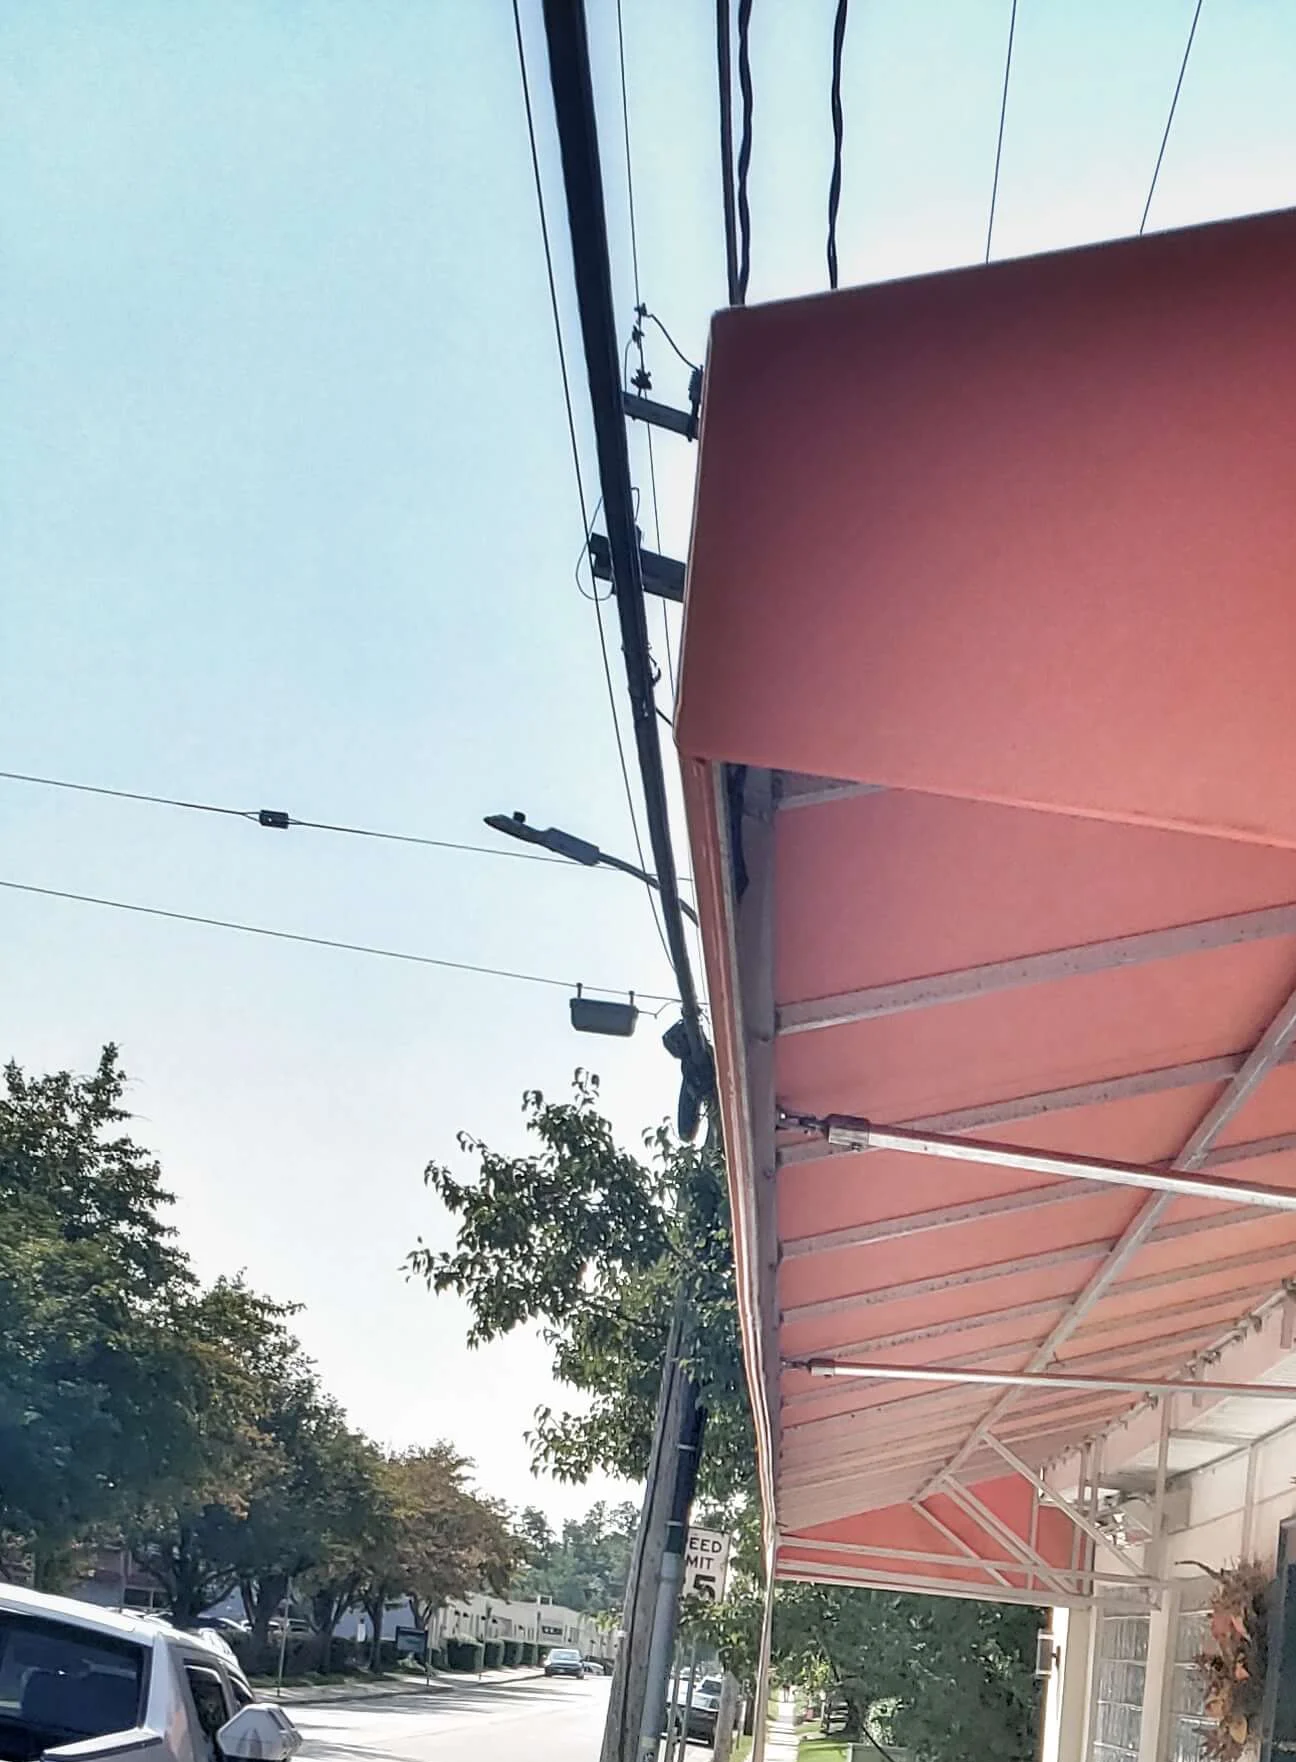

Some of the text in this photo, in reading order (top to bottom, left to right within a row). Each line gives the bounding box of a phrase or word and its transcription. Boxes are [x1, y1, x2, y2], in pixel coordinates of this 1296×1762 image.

[689, 1537, 722, 1553] EED
[686, 1554, 714, 1570] MIT
[693, 1574, 716, 1602] 5
